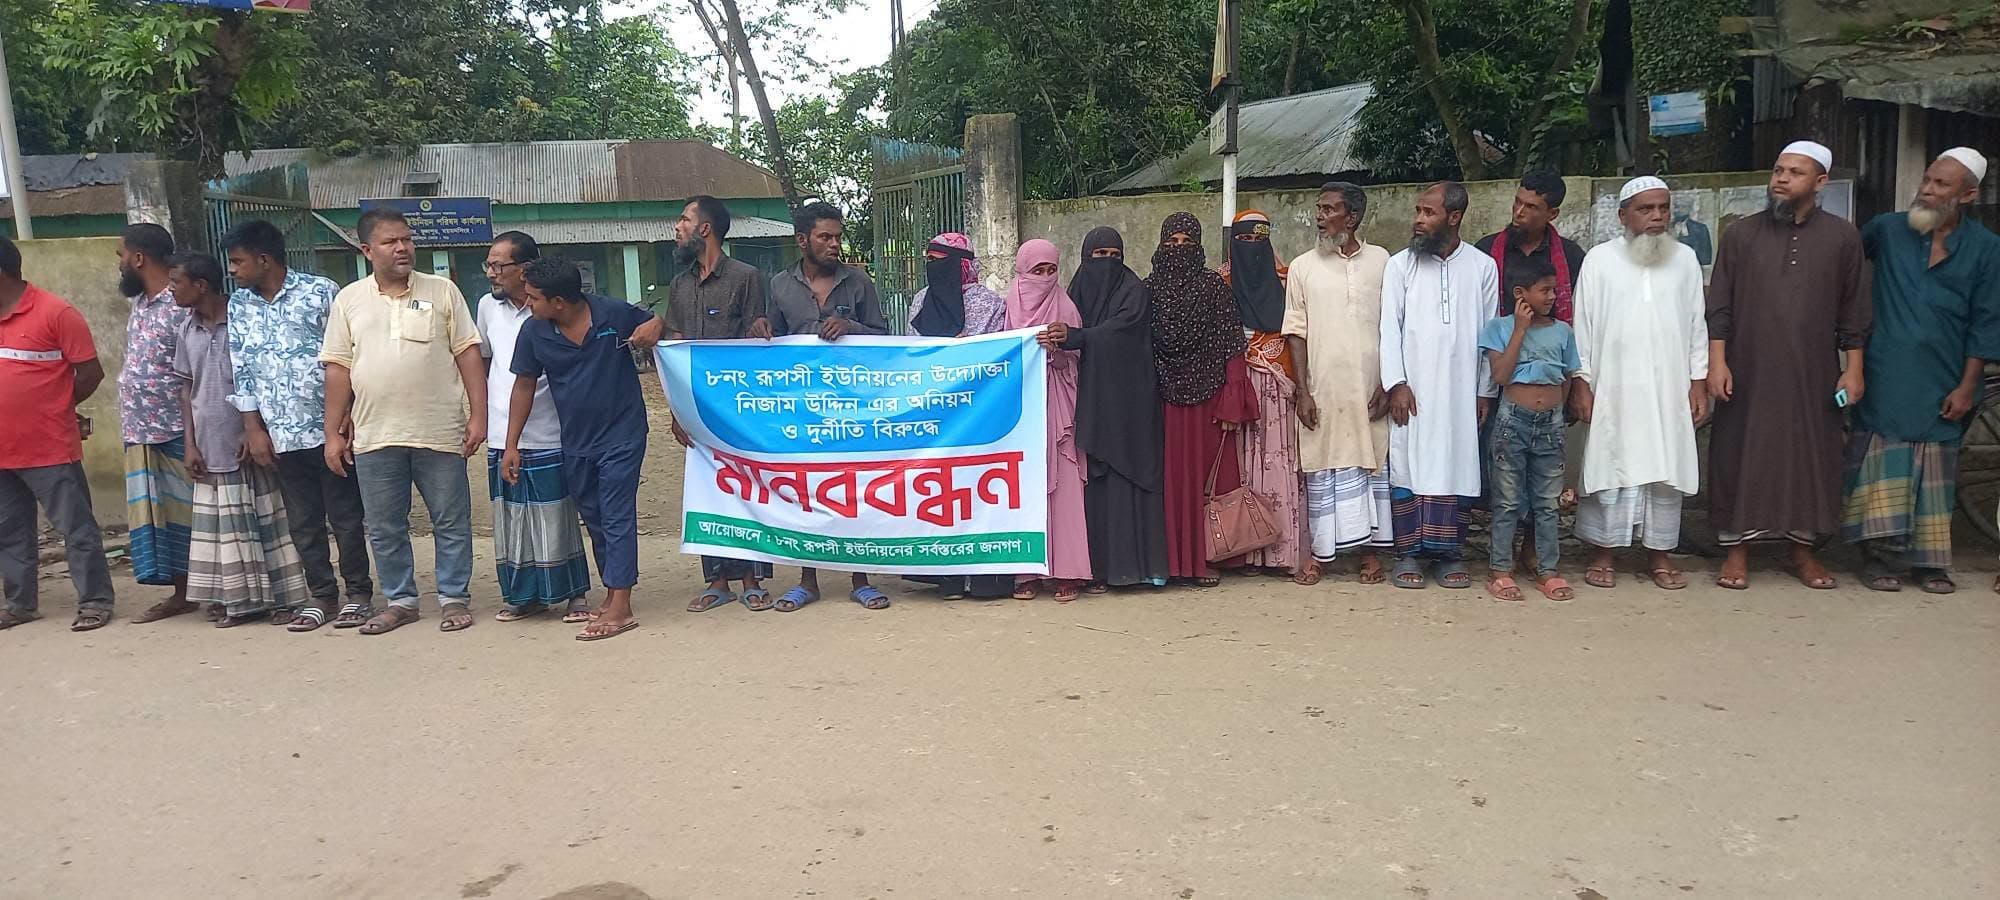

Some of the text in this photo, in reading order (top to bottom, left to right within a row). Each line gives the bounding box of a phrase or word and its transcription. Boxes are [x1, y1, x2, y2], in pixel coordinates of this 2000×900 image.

[754, 363, 813, 387] রূপসী
[819, 364, 924, 389] ইউনিয়নের
[928, 359, 1011, 383] উদ্যোক্তা
[734, 388, 975, 415] নিজাম উদ্দিন এর অনিয়ম
[781, 417, 942, 445] ও দুর্নীতি বিরুদ্ধে
[713, 451, 1024, 527] মানববন্ধন
[698, 520, 763, 543] আয়োজনে
[803, 539, 841, 555] রূপসী
[843, 541, 914, 558] ইউনিয়নের
[917, 540, 975, 557] সর্বস্তরের
[978, 537, 1023, 555] জনগণ
